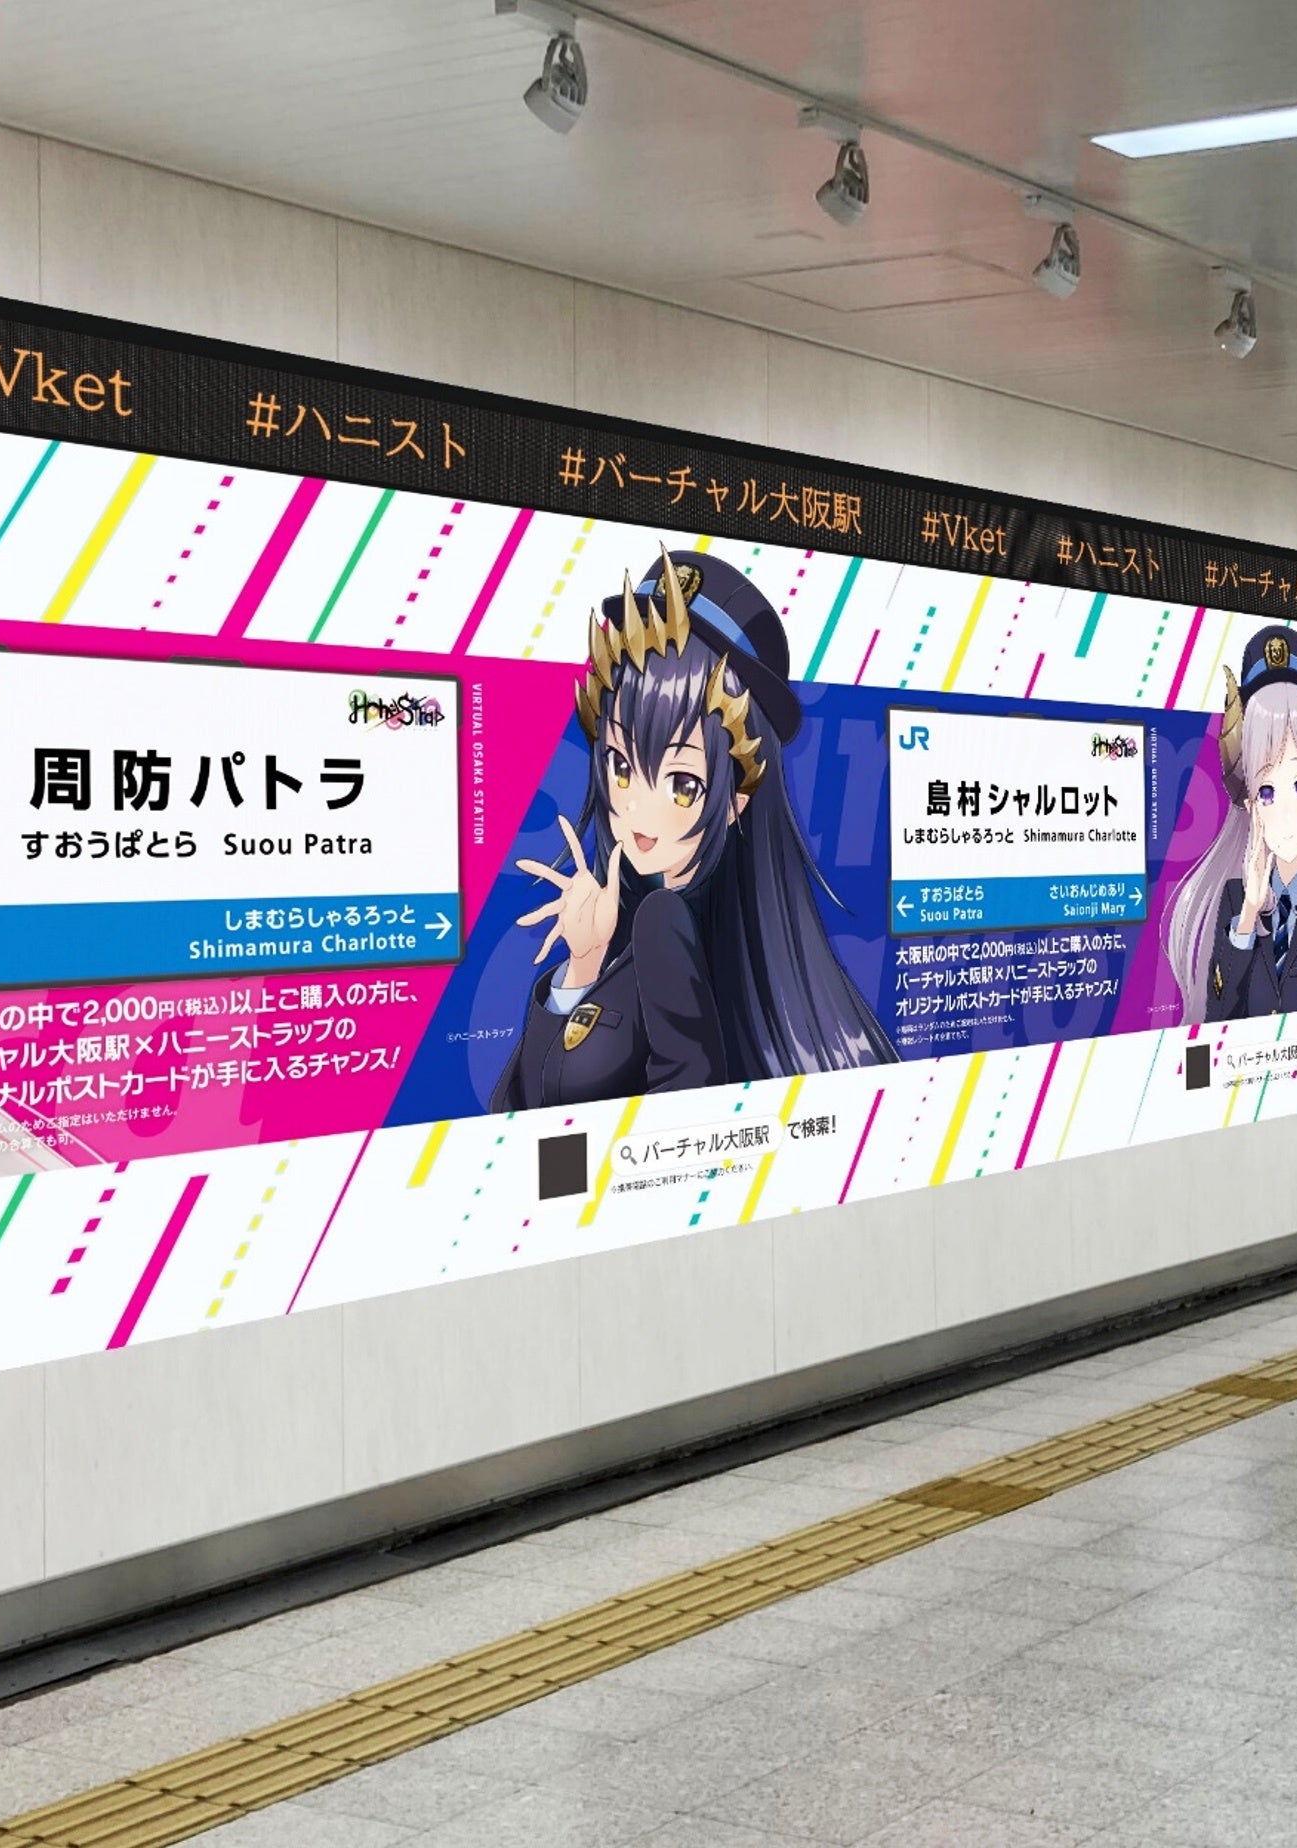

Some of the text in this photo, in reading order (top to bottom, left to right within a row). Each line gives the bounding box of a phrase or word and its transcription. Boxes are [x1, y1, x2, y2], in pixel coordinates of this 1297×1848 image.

[245, 392, 466, 469] #ハニスト
[559, 446, 862, 536] #バーチャル大阪駅
[921, 511, 1007, 557] #Vket
[1057, 534, 1160, 581] #ハニスト
[898, 725, 930, 751] JR
[471, 682, 485, 845] VIRTUAL OSAKA STATION
[29, 746, 368, 812] 周防パトラ
[926, 779, 1119, 817] 島村シャルロット
[21, 829, 198, 860] すおうぱとら
[223, 832, 373, 857] Suou Patra
[903, 827, 1015, 845] しまむらしゃるろっと
[1023, 828, 1137, 843] Shimamura Charlotte
[919, 884, 985, 904] すおうぱとら
[1048, 882, 1126, 901] さいおんじめあり
[225, 904, 417, 931] しまむらしゃるろっと
[919, 907, 983, 922] Suou Patra
[1063, 902, 1126, 919] Saionji Mary
[188, 930, 417, 960] Shimamura Charlotte
[643, 1125, 771, 1163] バーチャル大阪駅
